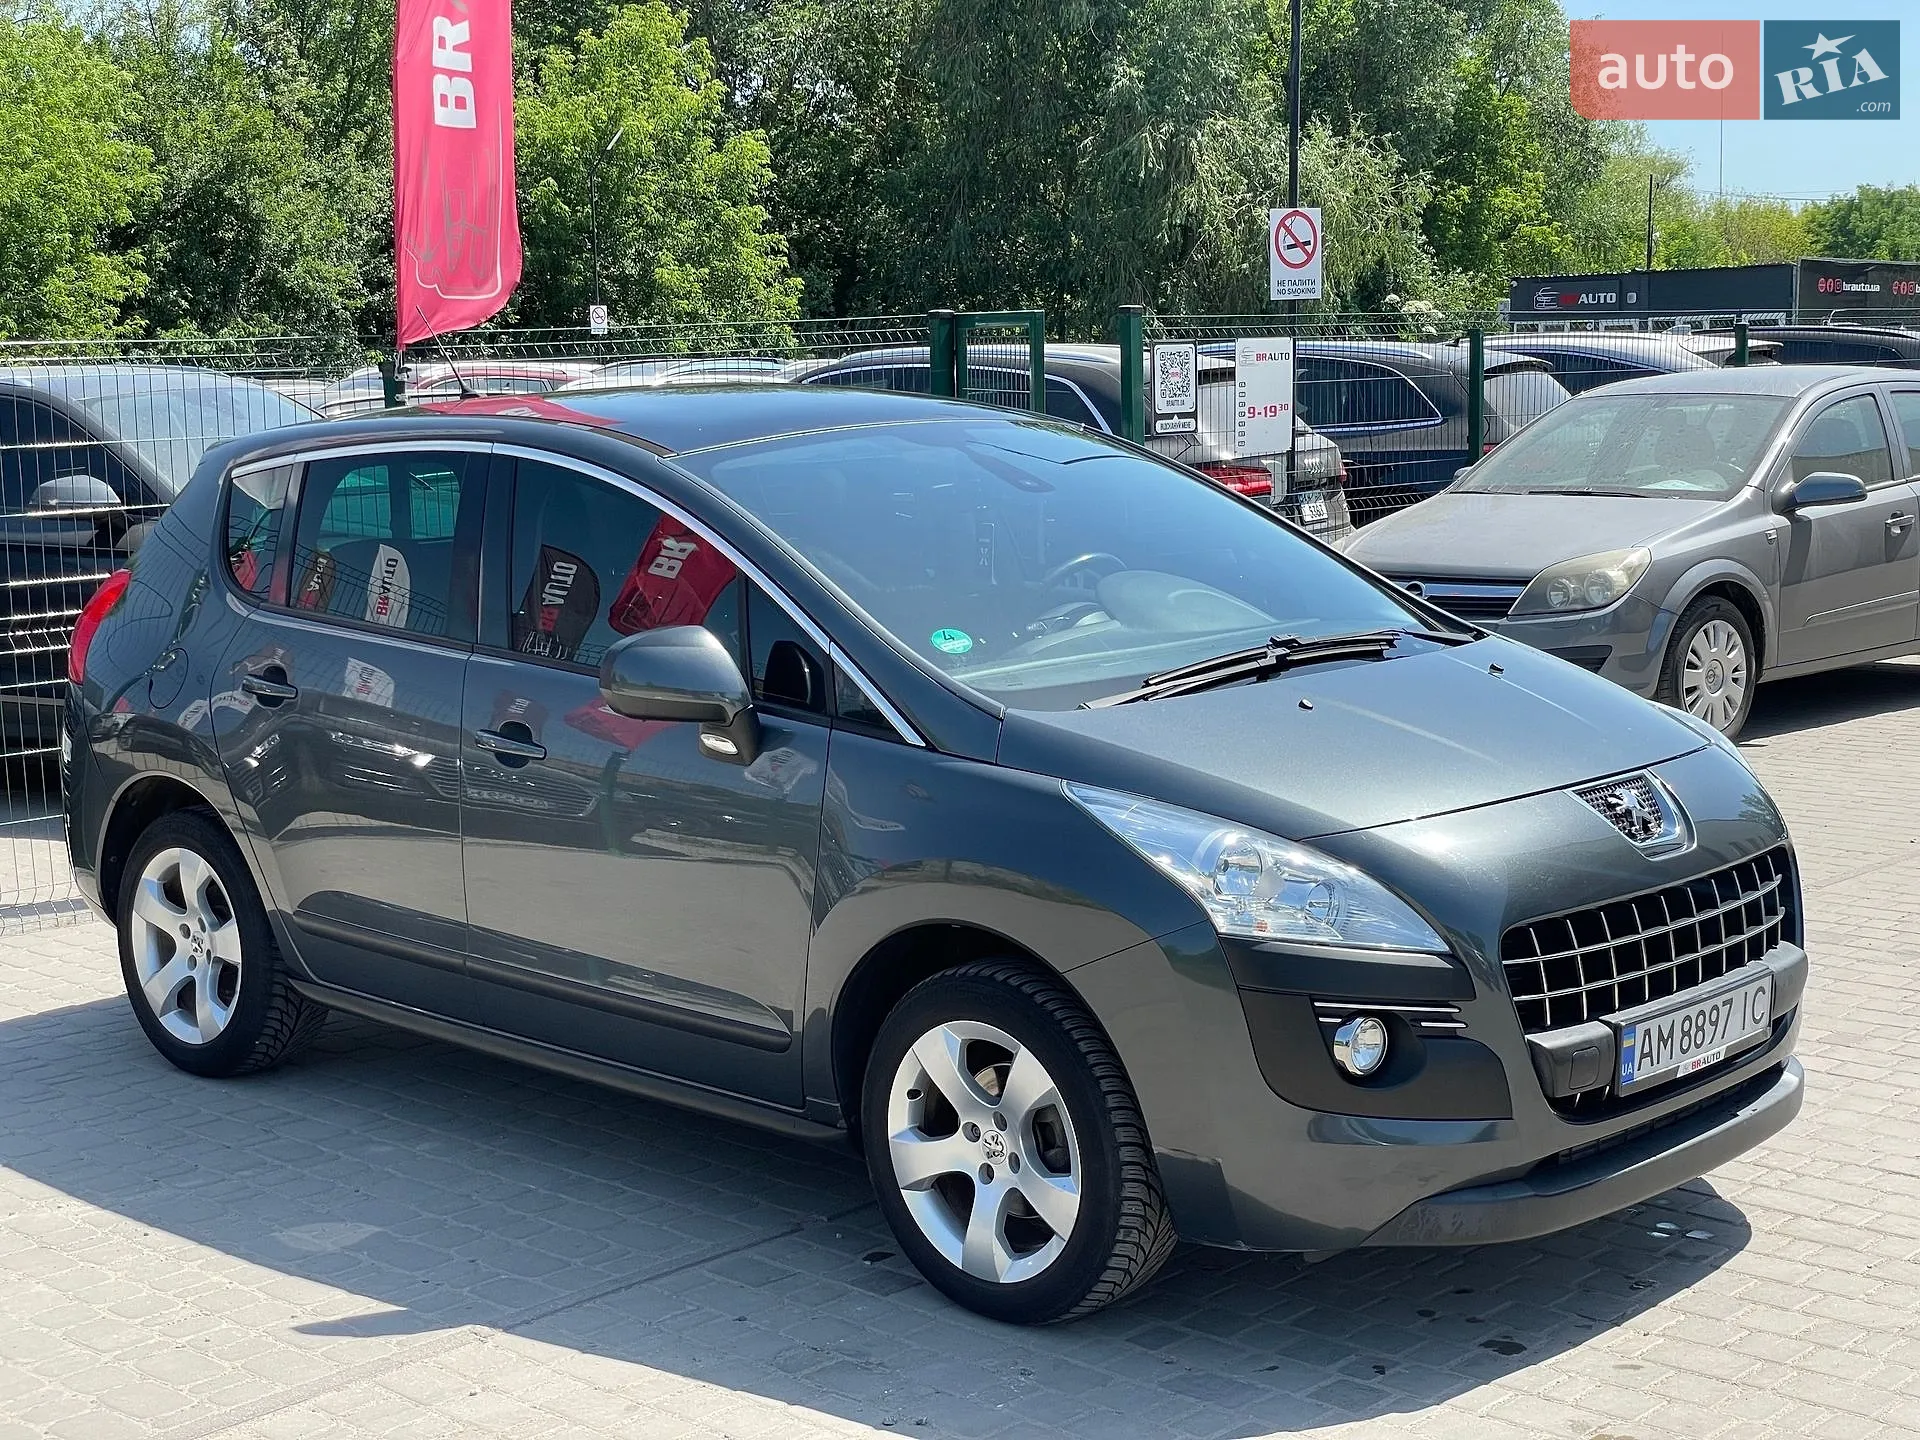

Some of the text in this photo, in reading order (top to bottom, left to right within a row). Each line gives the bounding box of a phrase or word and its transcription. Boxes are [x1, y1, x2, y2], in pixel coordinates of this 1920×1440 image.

[432, 0, 476, 129] BR
[1276, 278, 1316, 287] НЕ ПАЛИТИ
[1842, 281, 1881, 292] brauto.ua
[1276, 287, 1316, 296] NO SMOKING
[1255, 352, 1290, 362] BRAUTO
[1637, 986, 1766, 1071] AM 8897 IC
[1691, 1051, 1721, 1070] BRAUTO
[1621, 1063, 1634, 1076] UA
